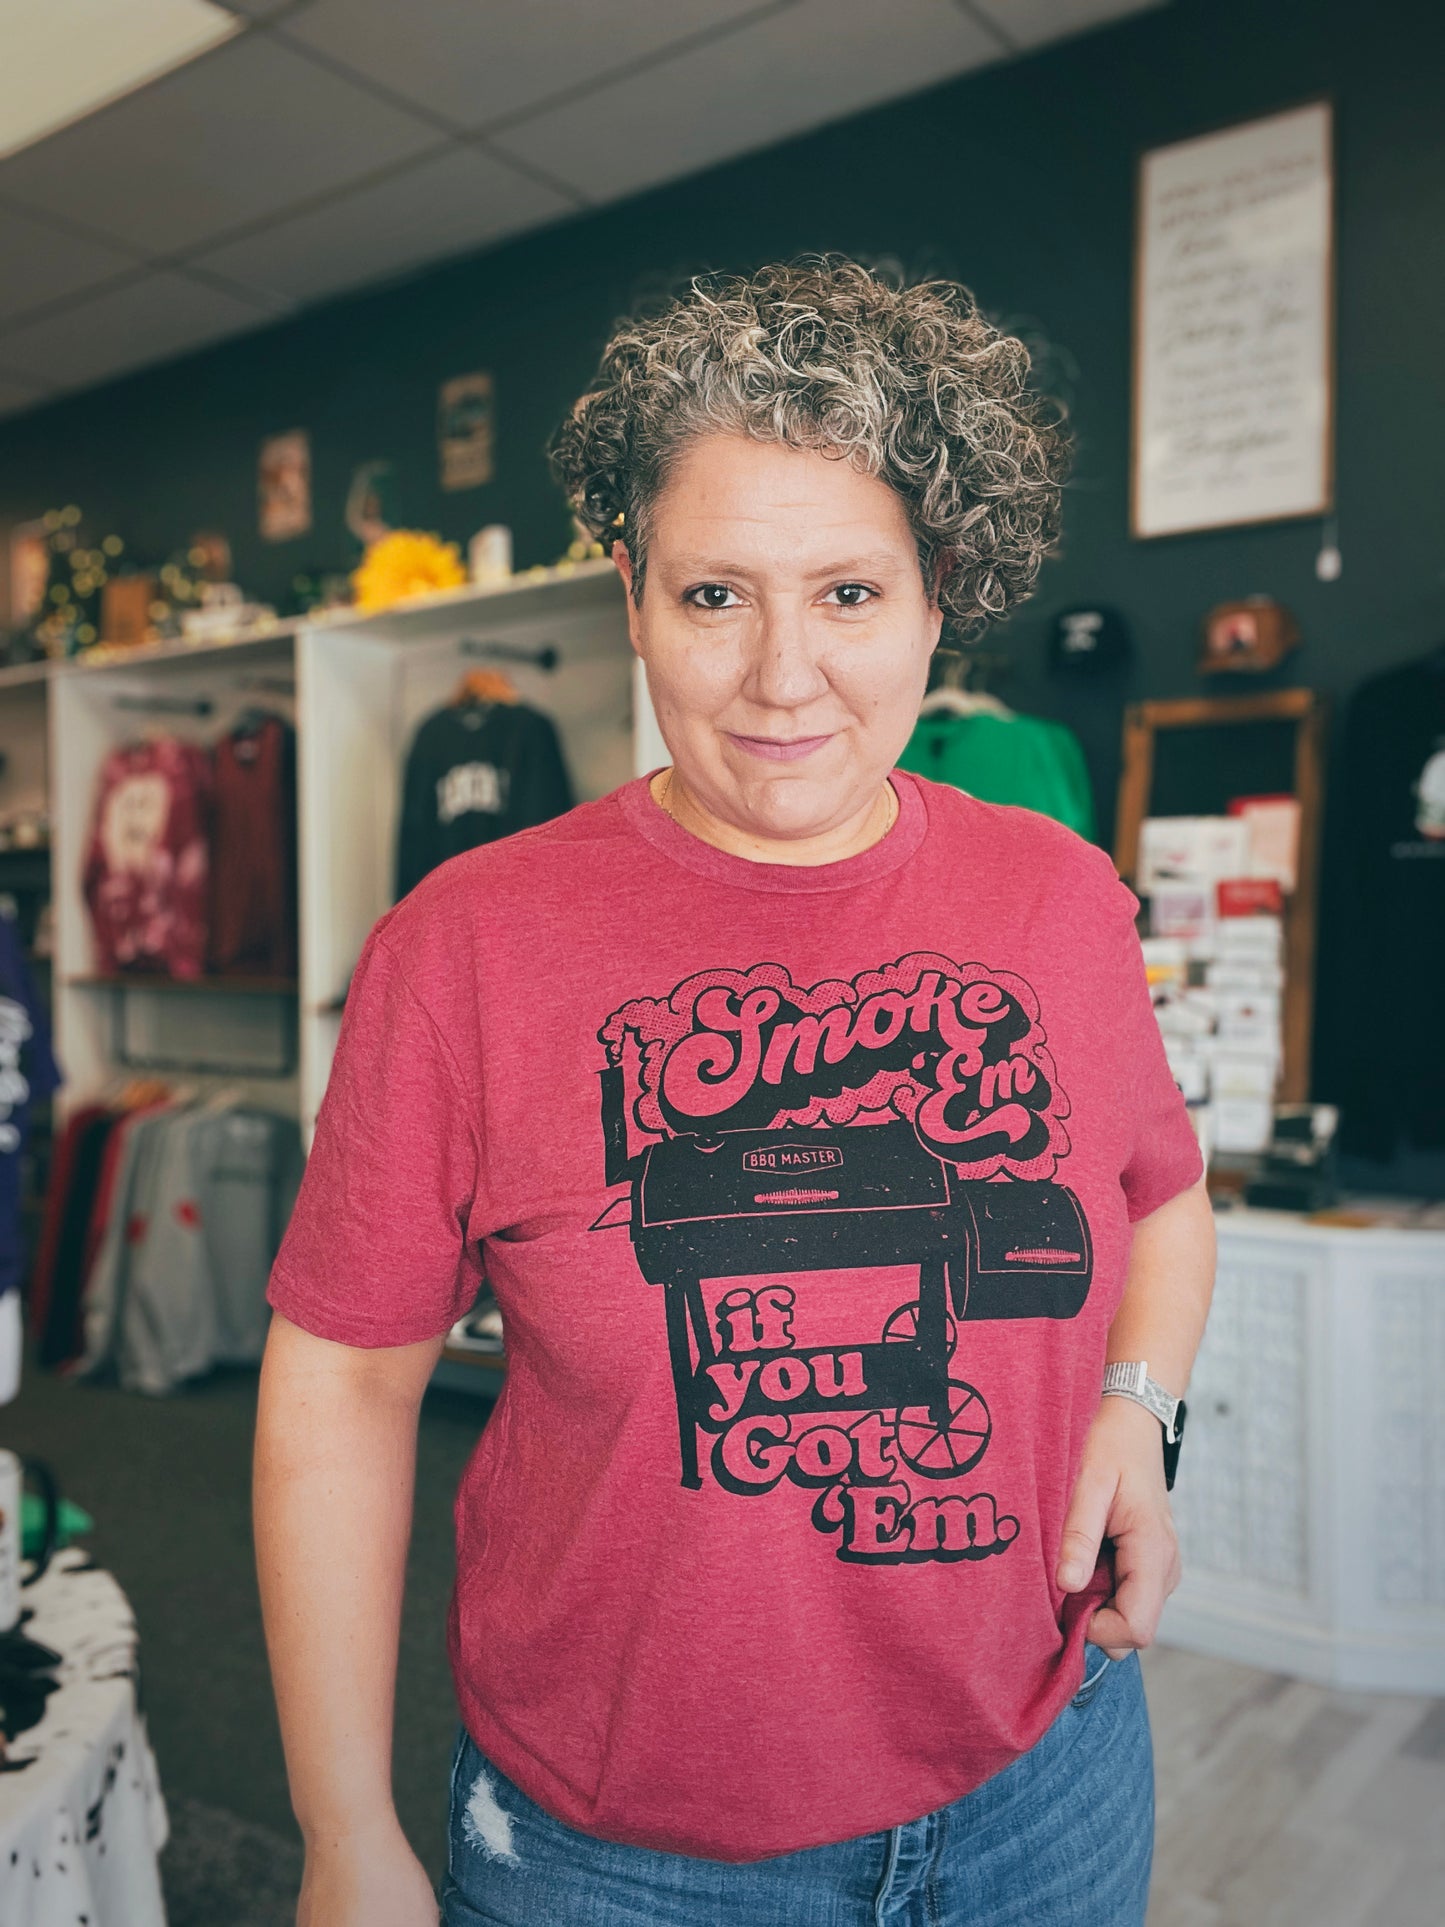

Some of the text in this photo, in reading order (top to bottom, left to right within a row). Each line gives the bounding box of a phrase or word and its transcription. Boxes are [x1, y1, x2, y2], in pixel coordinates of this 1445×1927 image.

[664, 970, 1010, 1117] Smoke
[749, 1149, 837, 1168] BBQ MASTER
[720, 1286, 796, 1353] if
[706, 1351, 868, 1422] you
[719, 1410, 898, 1488] Got
